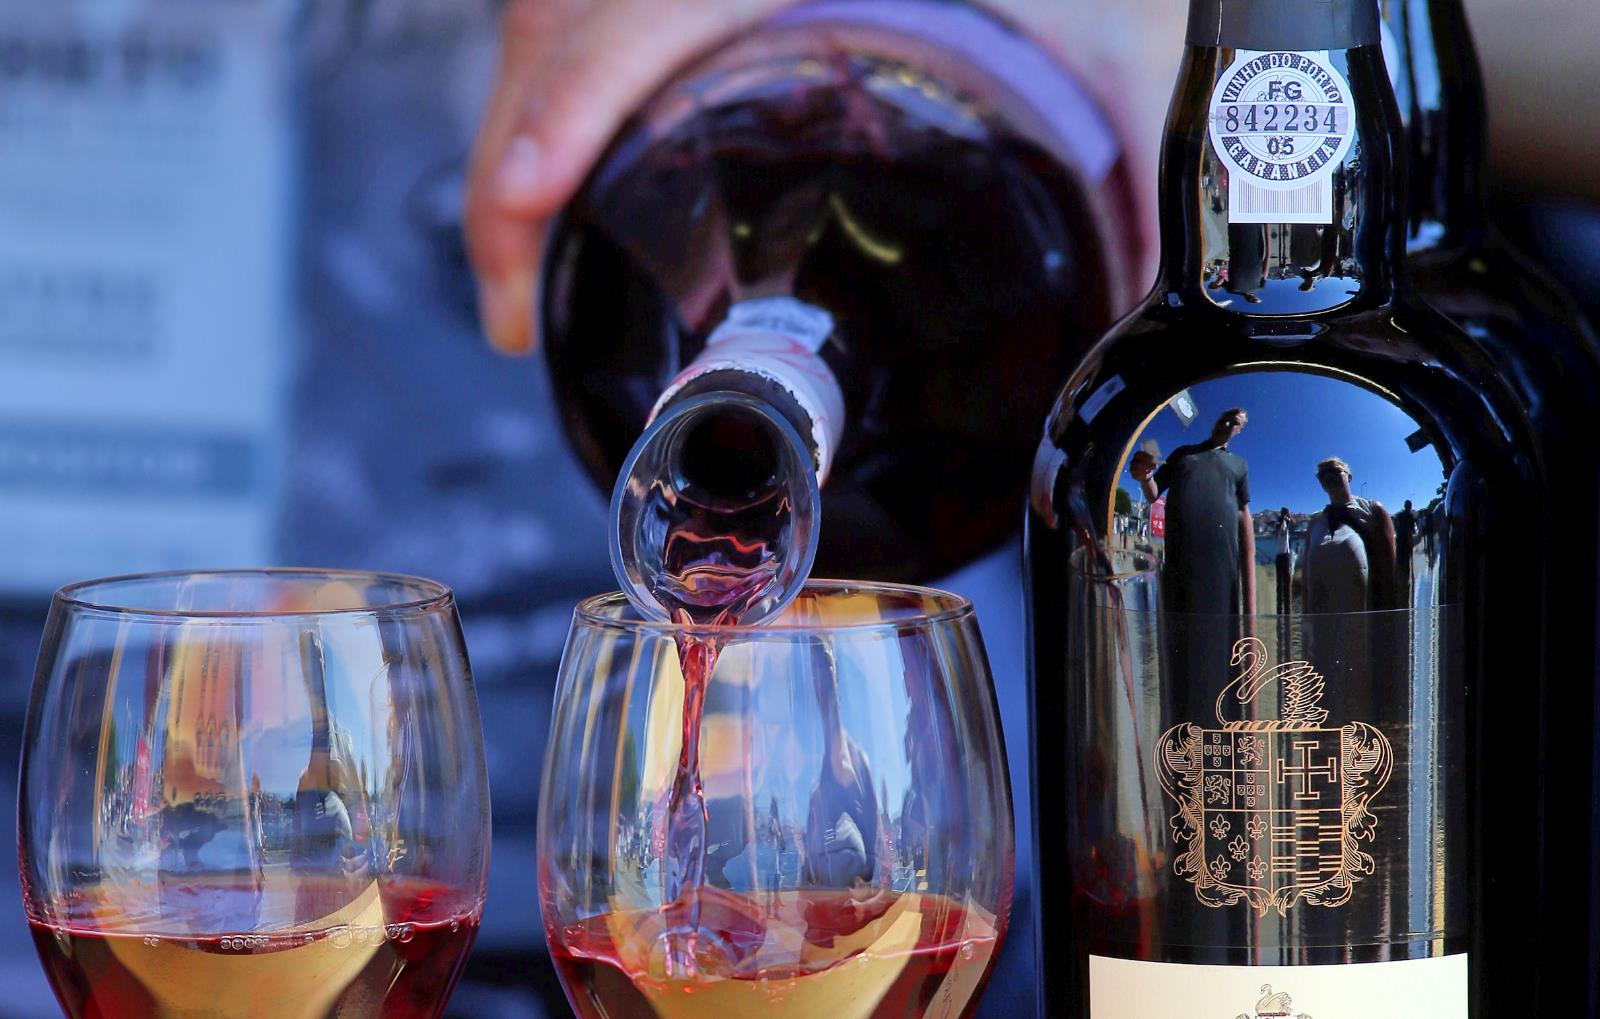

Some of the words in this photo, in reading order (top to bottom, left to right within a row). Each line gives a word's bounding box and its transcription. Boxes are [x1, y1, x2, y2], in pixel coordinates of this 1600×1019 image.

[1223, 60, 1263, 102] VINHO
[1269, 53, 1291, 68] DO
[1298, 59, 1340, 102] PORTO
[1268, 81, 1302, 100] FG
[1225, 104, 1337, 133] 842234
[1229, 142, 1336, 180] GARANTIA
[1268, 138, 1295, 155] 05
